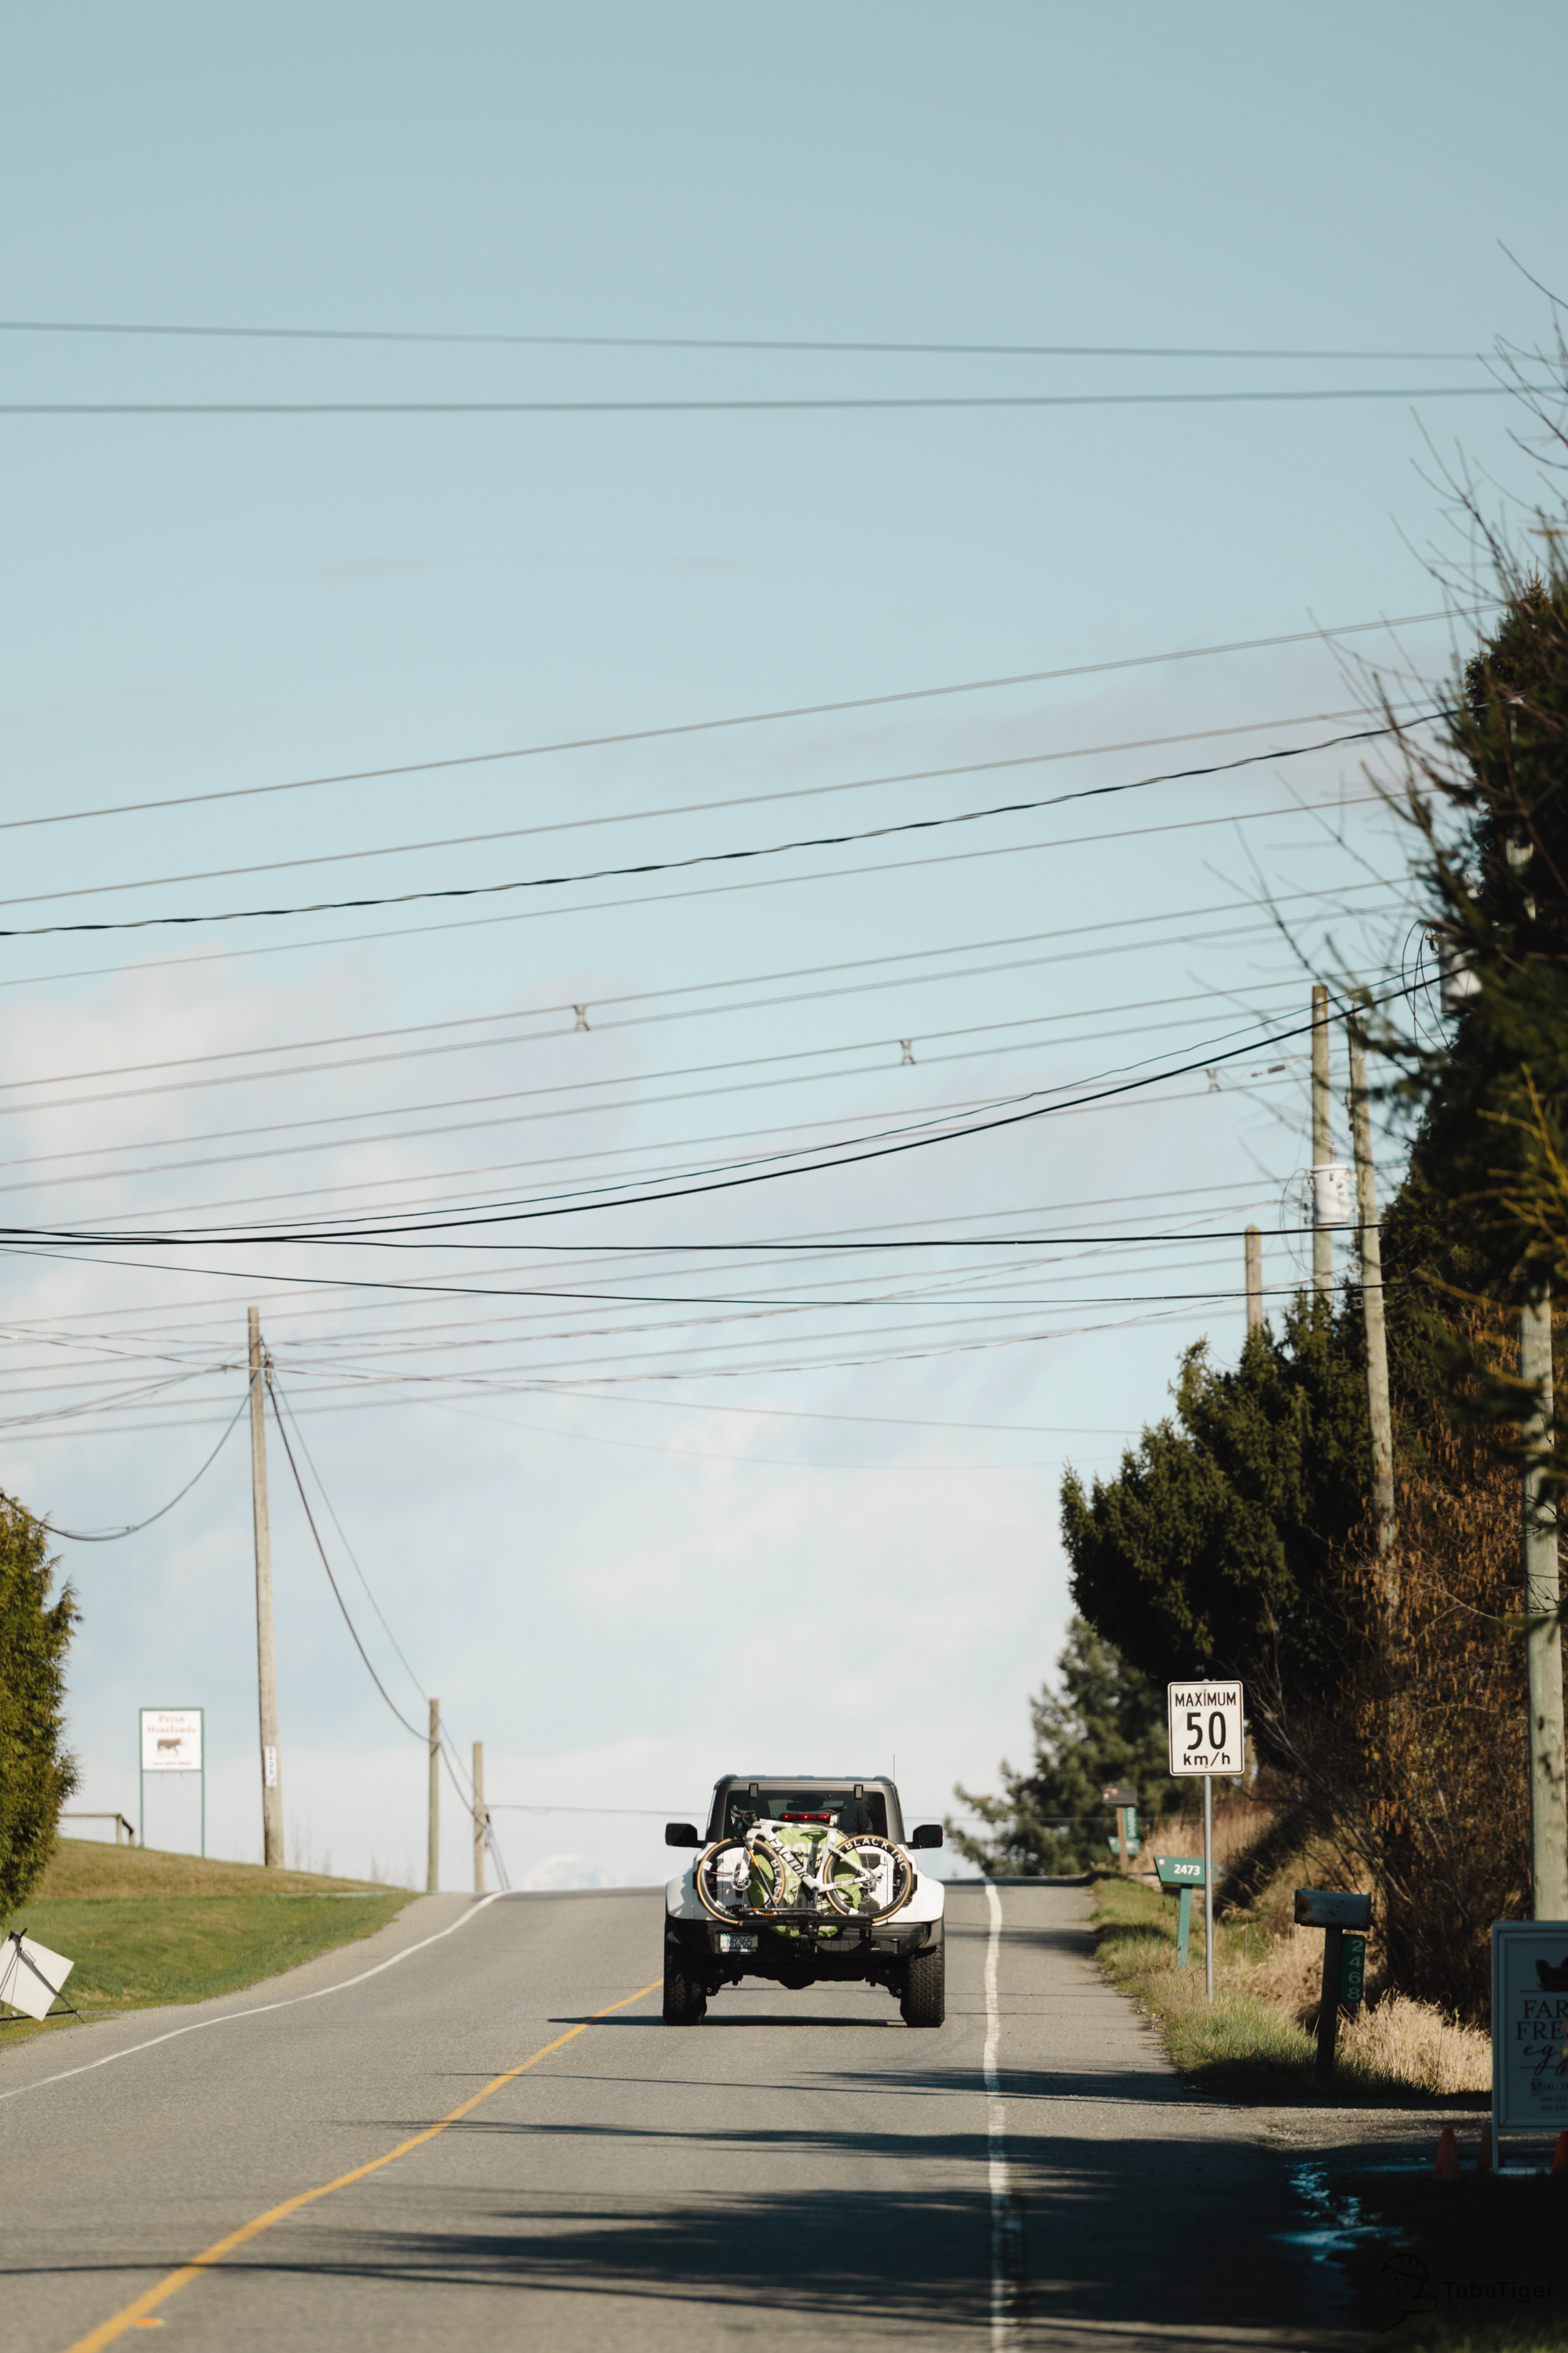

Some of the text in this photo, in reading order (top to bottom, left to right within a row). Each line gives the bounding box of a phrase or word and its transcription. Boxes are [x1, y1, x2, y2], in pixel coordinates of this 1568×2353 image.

[1175, 1692, 1236, 1707] MAXIMUM
[1187, 1711, 1226, 1750] 50
[1183, 1751, 1231, 1766] km/h
[769, 1838, 808, 1879] FACTOR
[845, 1838, 907, 1871] BLACK INC
[1173, 1864, 1201, 1876] 2473
[727, 1937, 753, 1947] MR365
[1347, 1940, 1363, 2000] 2468
[1516, 2021, 1568, 2040] FRE
